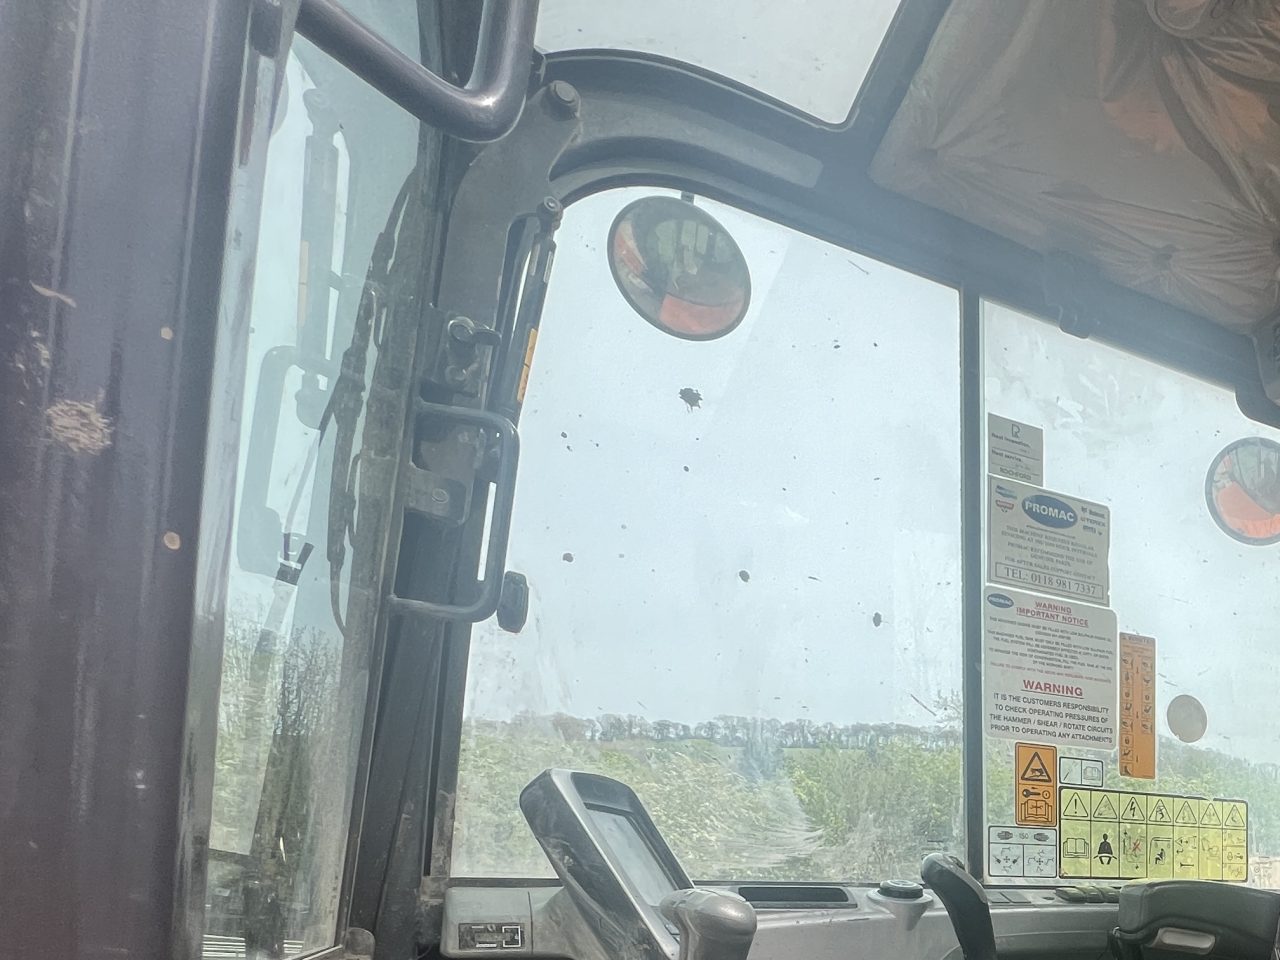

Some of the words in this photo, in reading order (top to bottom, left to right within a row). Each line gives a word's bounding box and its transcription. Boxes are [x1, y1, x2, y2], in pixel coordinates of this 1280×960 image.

[1024, 500, 1075, 522] PROMAC
[1004, 567, 1028, 580] TEL:
[1030, 573, 1054, 586] 0118
[1056, 578, 1072, 591] 981
[1074, 583, 1097, 595] 7337
[1034, 601, 1072, 613] WARNING
[1016, 607, 1060, 621] IMPORTANT
[1061, 615, 1089, 627] NOTICE
[1022, 679, 1083, 697] WARNING
[993, 692, 1000, 700] IT
[1008, 694, 1021, 702] THE
[1022, 696, 1062, 708] CUSTOMERS
[989, 713, 1002, 721] THE
[1003, 715, 1032, 725] HAMMER
[1037, 719, 1058, 728] SHEAR
[1063, 722, 1086, 731] ROTATE
[995, 703, 1004, 711] TO
[1004, 705, 1027, 713] CHECK
[1028, 708, 1064, 719] OPERATING
[1065, 712, 1100, 723] PRESSURES
[1021, 727, 1057, 738] OPERATING
[1057, 731, 1071, 739] ANY
